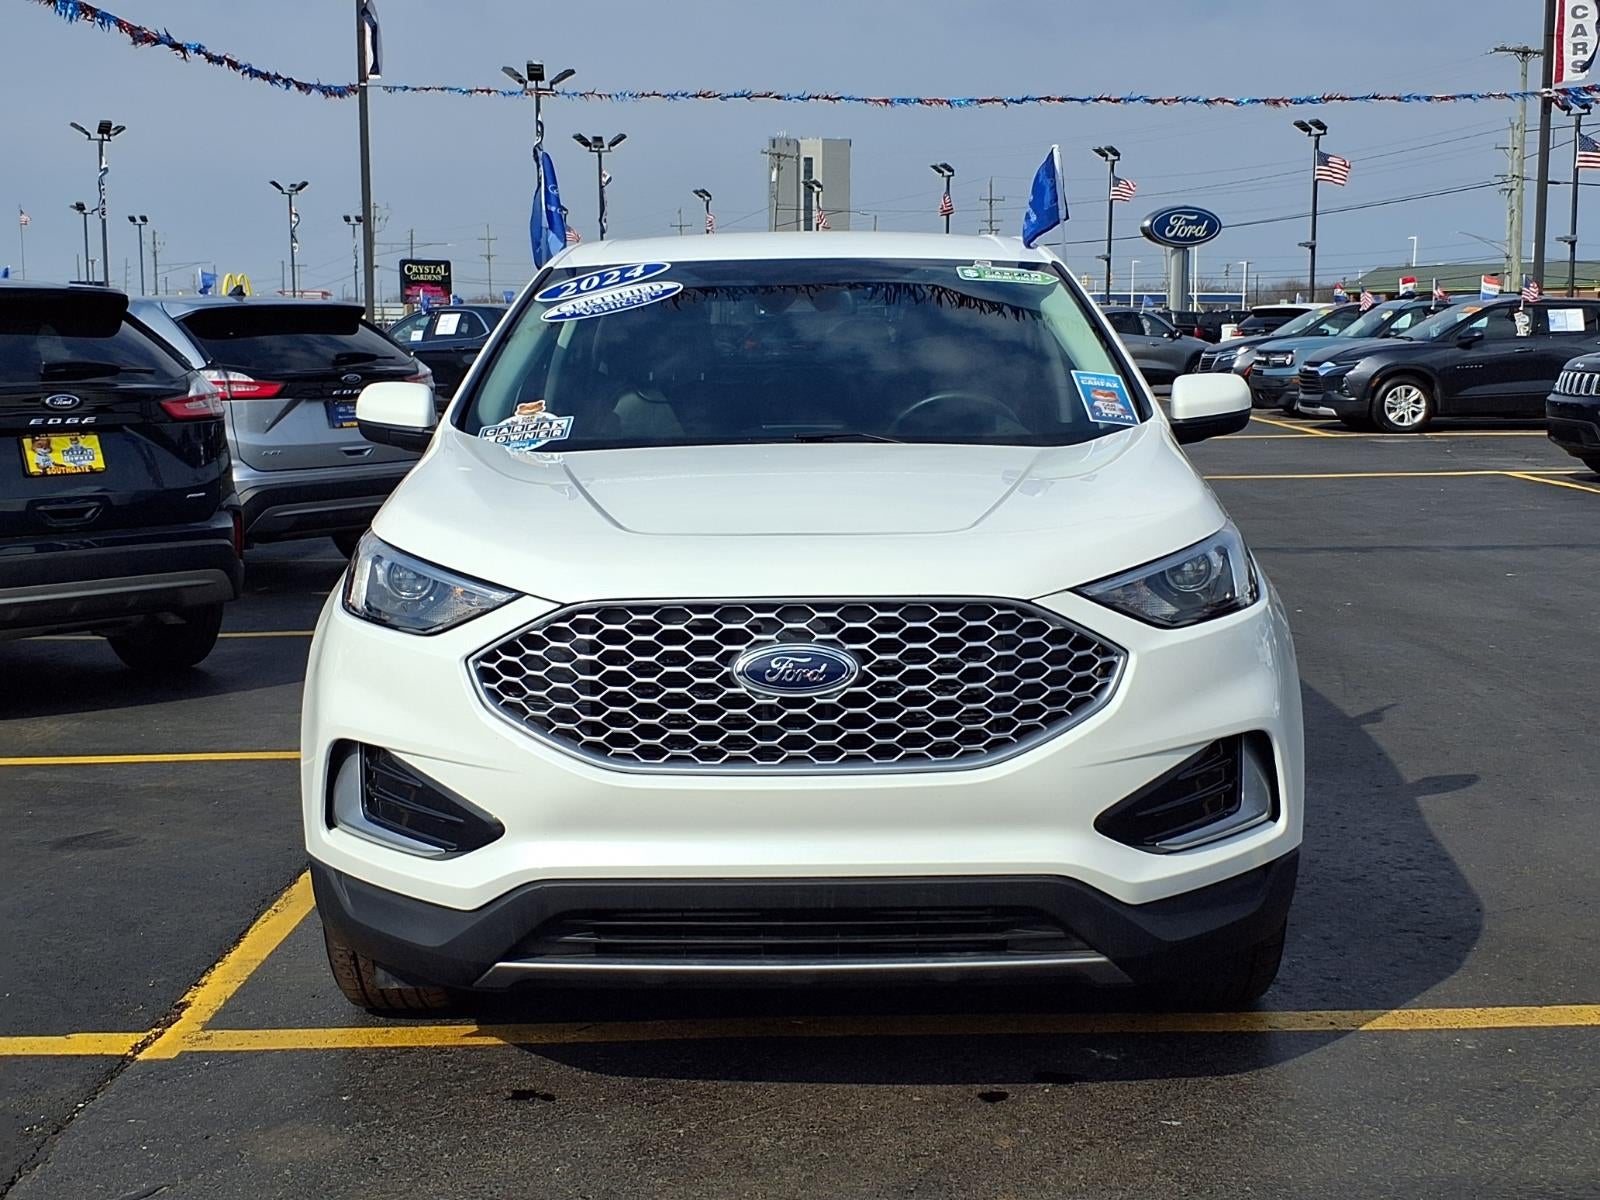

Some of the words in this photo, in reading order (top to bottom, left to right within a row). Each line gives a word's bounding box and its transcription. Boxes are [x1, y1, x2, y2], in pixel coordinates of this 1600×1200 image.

[1570, 4, 1589, 73] CARS
[1165, 213, 1209, 238] Ford
[404, 263, 449, 276] CRYSTAL
[558, 263, 646, 298] 2024
[1081, 379, 1120, 388] CARFAX
[29, 416, 96, 425] EDGE
[485, 421, 565, 437] CARFAX
[46, 466, 91, 475] SOUTHGATE
[765, 656, 828, 682] Ford
